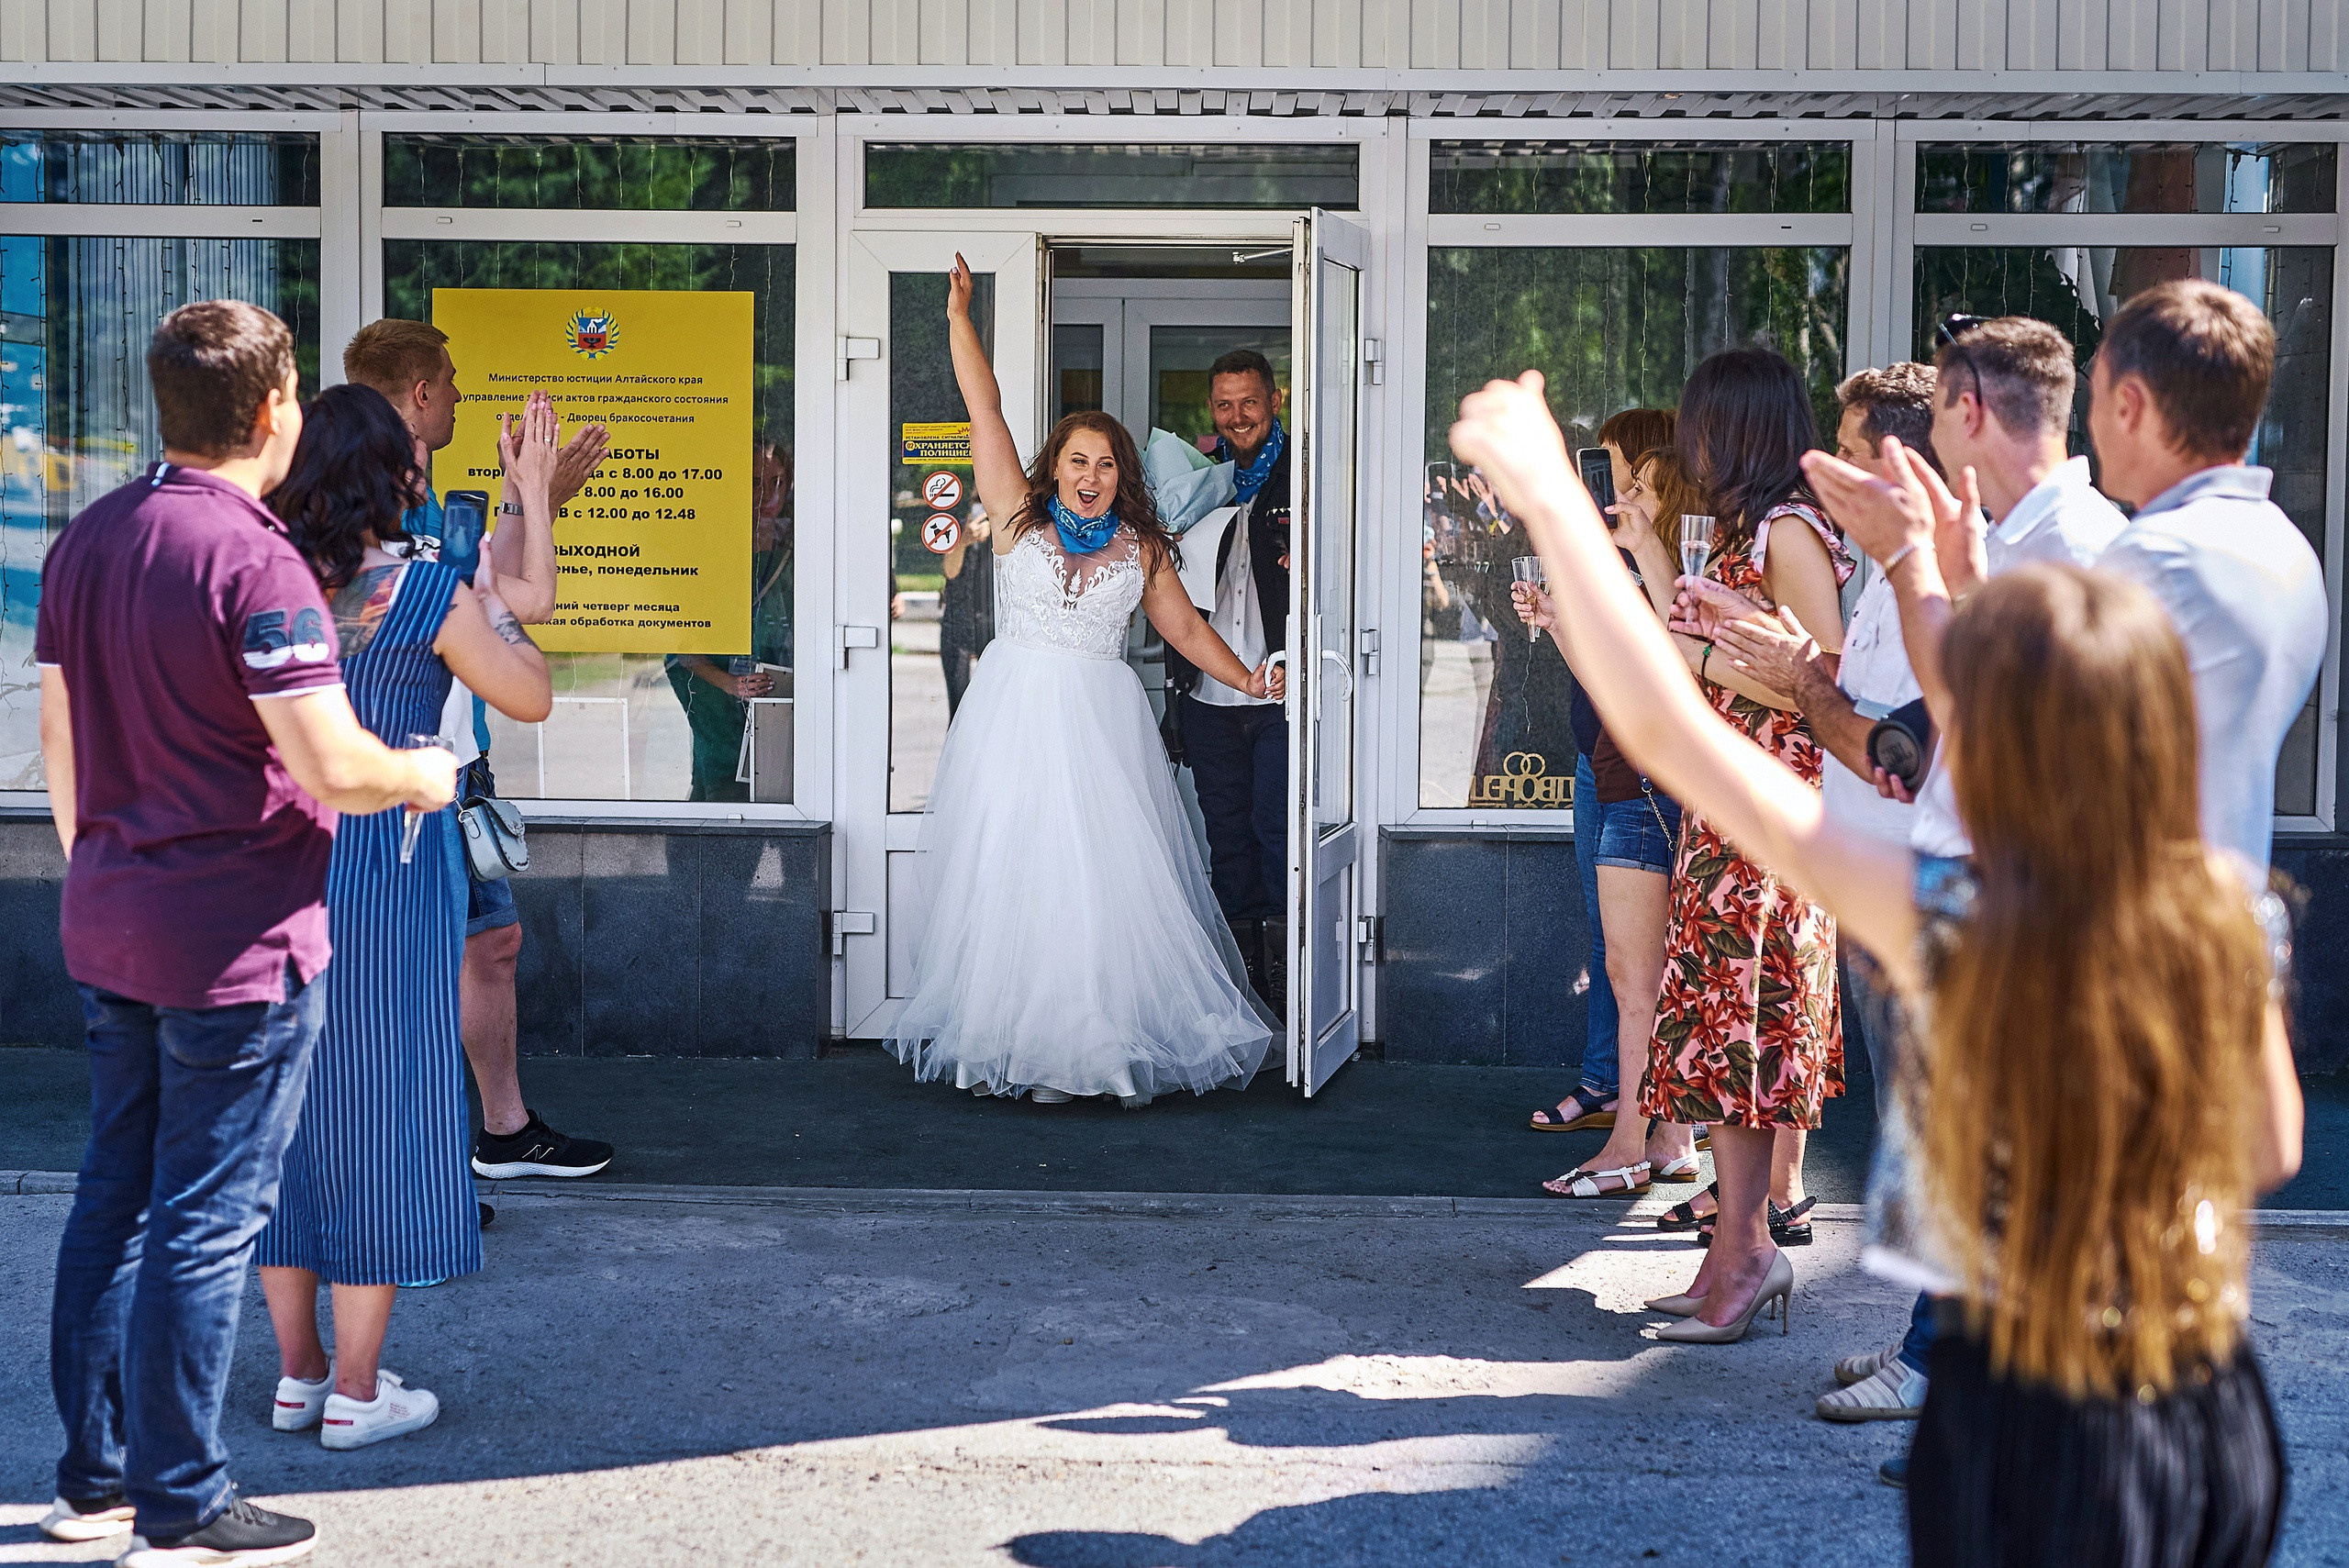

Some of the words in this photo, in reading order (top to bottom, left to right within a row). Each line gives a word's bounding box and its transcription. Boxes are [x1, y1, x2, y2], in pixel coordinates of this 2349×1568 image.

[488, 373, 564, 384] Министерство
[566, 375, 613, 384] юстиции
[614, 373, 676, 384] Алтайского
[678, 376, 704, 386] края
[462, 394, 525, 404] управление
[565, 395, 596, 403] актов
[597, 395, 672, 405] гражданского
[674, 395, 729, 405] состояния
[566, 413, 607, 424] Дворец
[608, 413, 696, 425] бракосочетания
[608, 470, 618, 479] с
[622, 467, 654, 479] 8.00
[658, 471, 677, 482] до
[682, 468, 723, 481] 17.00
[584, 485, 616, 498] 8.00
[619, 489, 639, 500] до
[643, 486, 685, 499] 16.00
[573, 509, 584, 518] с
[587, 506, 628, 519] 12.00
[631, 510, 651, 522] до
[654, 507, 696, 520] 12.48
[596, 565, 700, 577] понедельник
[582, 603, 630, 613] четверг
[633, 604, 681, 614] месяца
[569, 617, 635, 628] обработка
[637, 619, 713, 629] документов
[242, 607, 330, 669] 56
